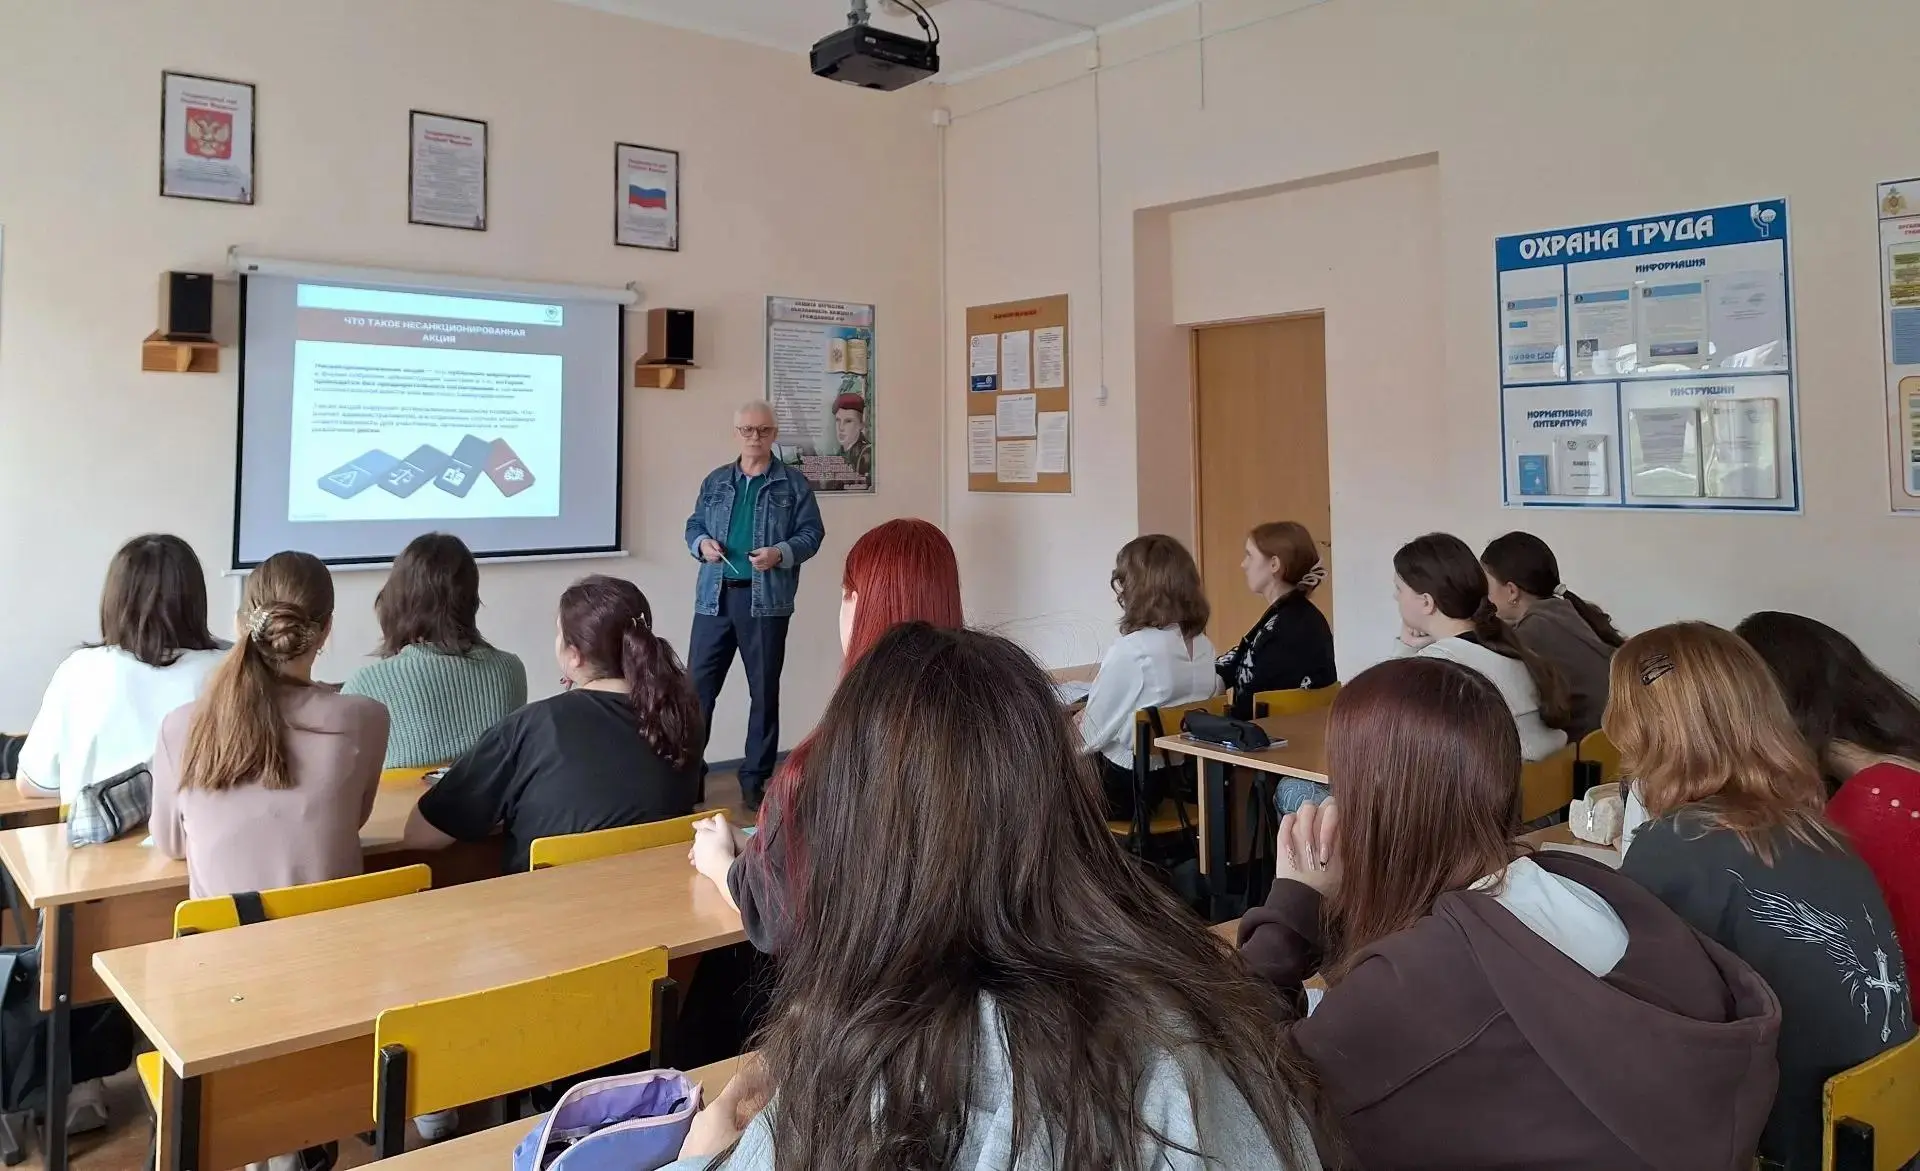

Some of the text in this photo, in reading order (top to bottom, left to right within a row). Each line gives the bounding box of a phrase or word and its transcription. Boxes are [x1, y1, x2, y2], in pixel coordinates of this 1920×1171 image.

[1519, 214, 1714, 260] ОХРАНА ТРУДА
[1635, 257, 1706, 274] ИНФОРМАЦИЯ
[344, 316, 526, 337] ЧТО ТАКОЕ НЕСАНКЦИОНИРОВАННАЯ
[422, 334, 456, 344] АКЦИЯ
[1669, 385, 1736, 397] ИНСТРУКЦИИ
[1527, 408, 1593, 420] НОРМАТИВНАЯ
[1532, 418, 1588, 429] ЛИТЕРАТУРА
